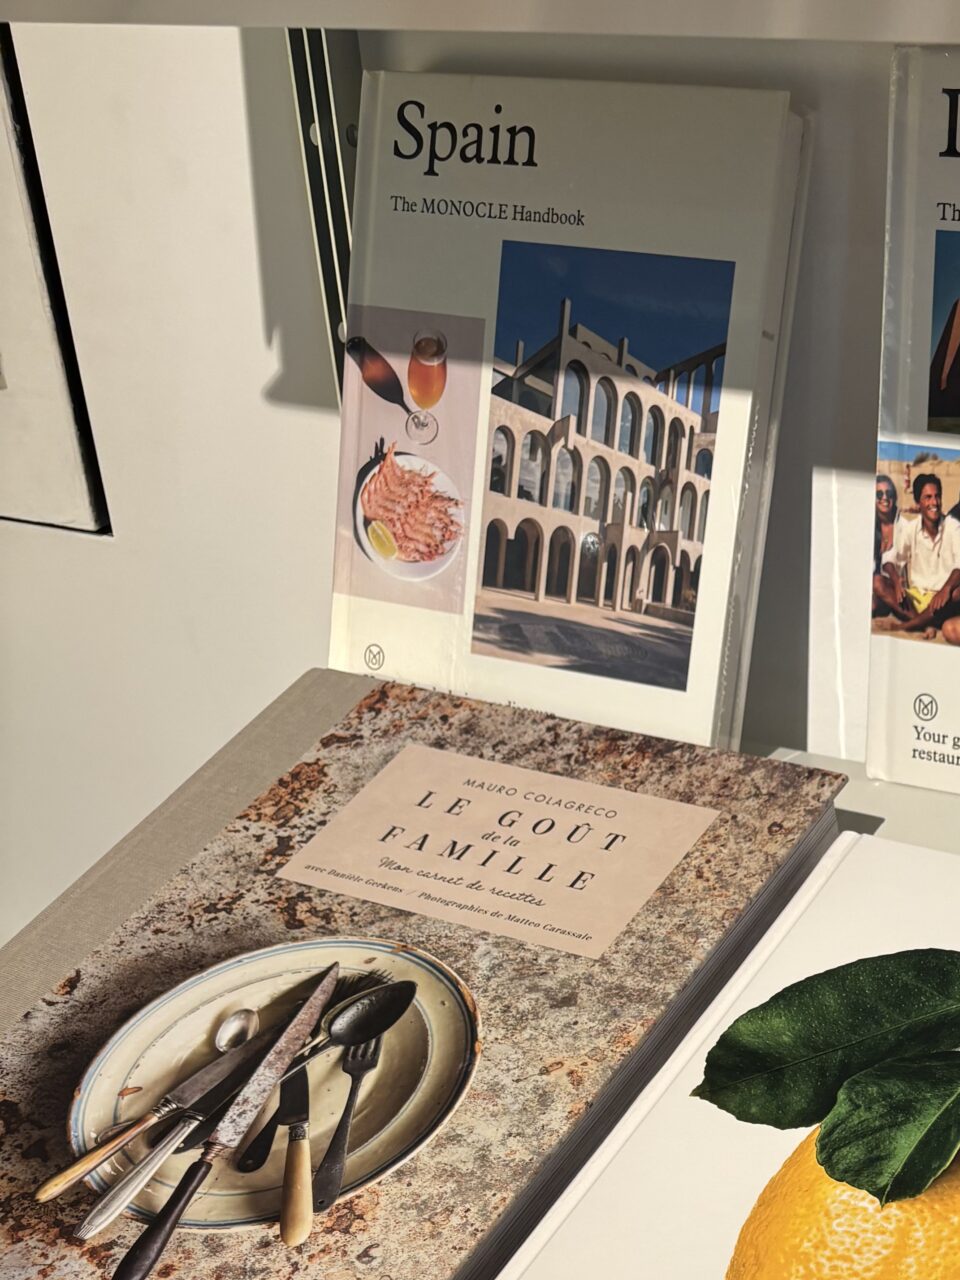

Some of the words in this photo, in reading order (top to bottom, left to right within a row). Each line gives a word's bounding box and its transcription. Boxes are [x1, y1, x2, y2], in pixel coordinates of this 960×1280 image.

[393, 100, 538, 177] Spain
[390, 196, 418, 214] The
[420, 198, 508, 220] MONOCLE
[511, 205, 585, 227] Handbook
[913, 725, 949, 745] Your
[414, 790, 471, 818] LE
[496, 809, 627, 852] GOÛT
[462, 777, 519, 798] MAURO
[523, 791, 618, 820] COLAGRECO
[377, 825, 596, 891] FAMILLE
[480, 829, 501, 844] de
[501, 832, 521, 848] la
[304, 863, 326, 875] avec
[327, 868, 364, 885] Danièle
[417, 891, 490, 917] Photographies
[490, 909, 504, 920] de
[504, 913, 542, 930] Matteo
[541, 920, 594, 942] Carassale
[377, 856, 414, 876] Mon
[415, 867, 464, 888] carnet
[466, 875, 487, 893] de
[488, 884, 548, 908] recettes
